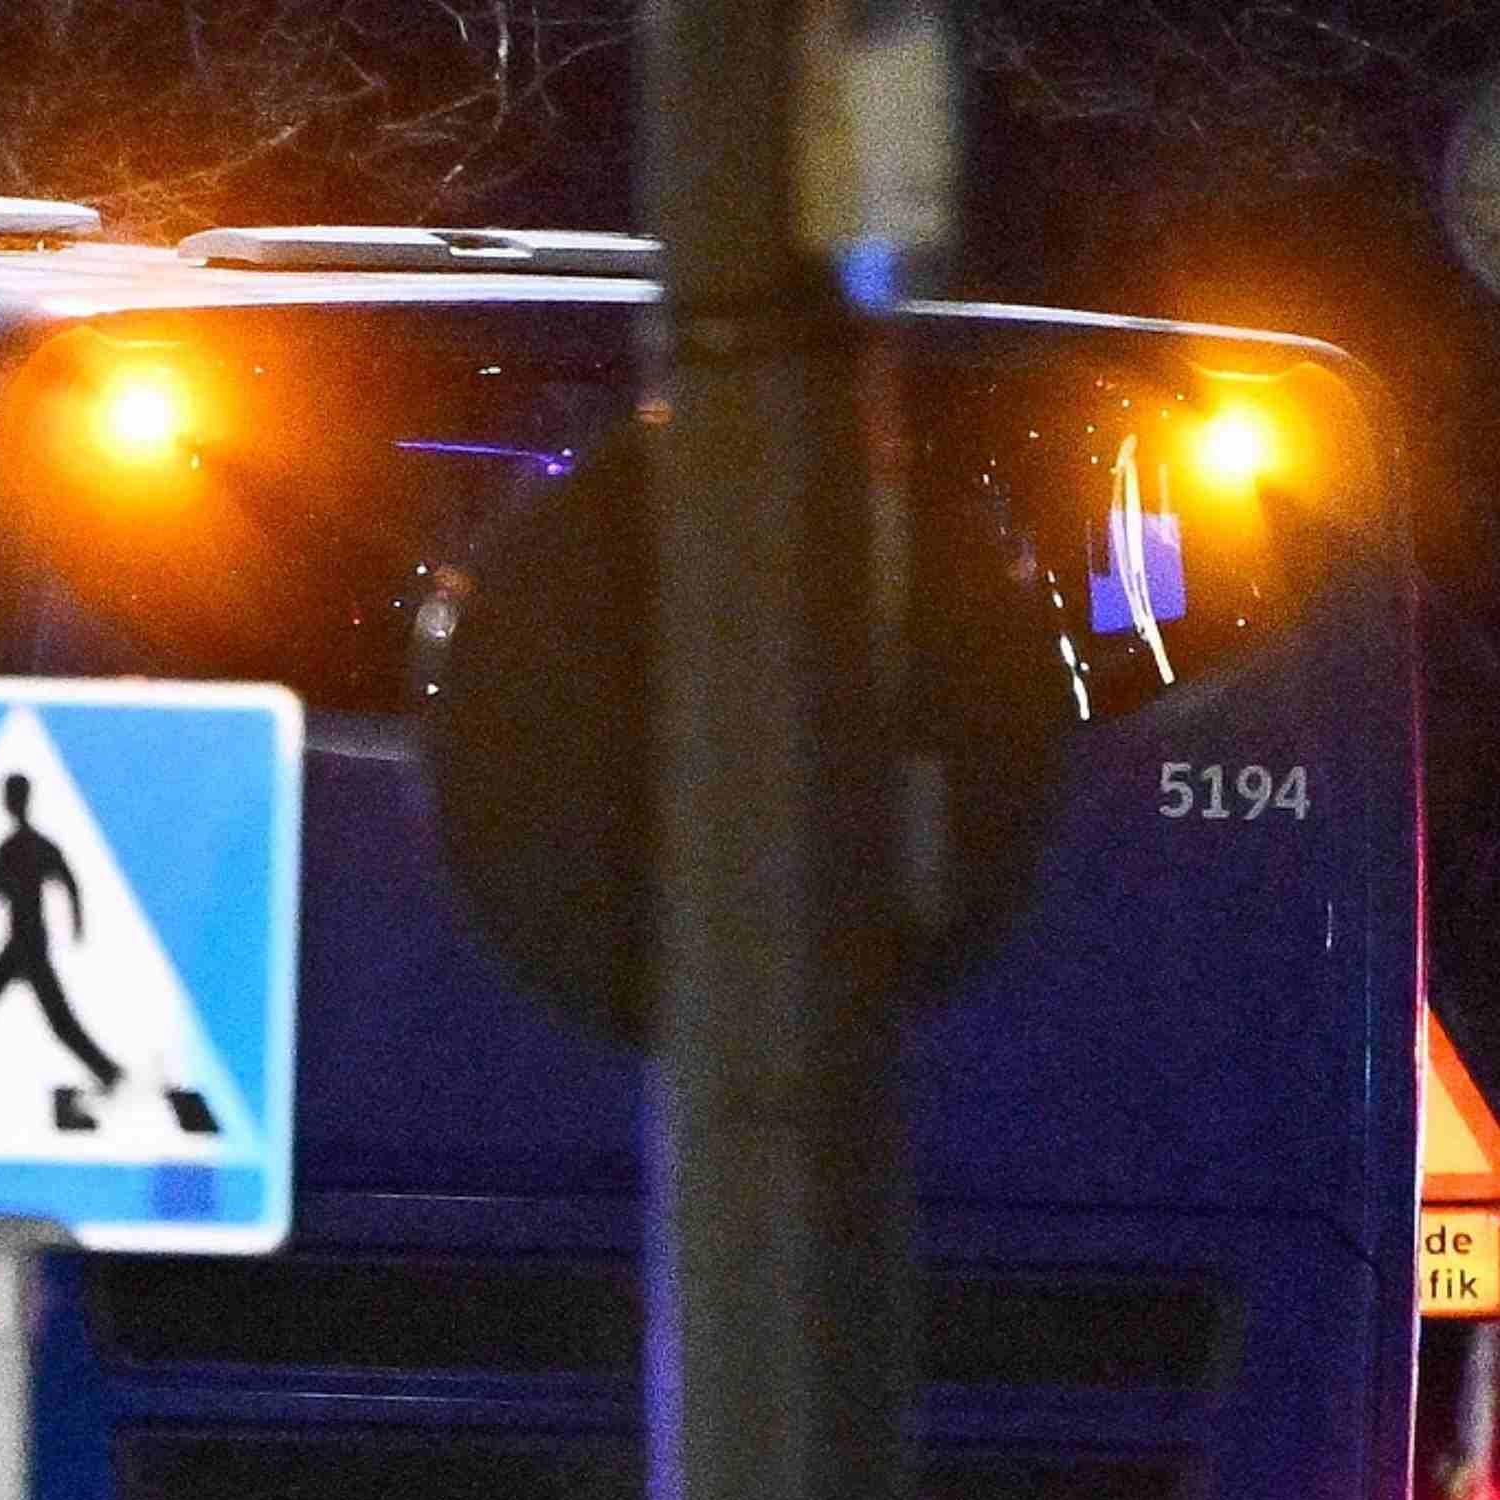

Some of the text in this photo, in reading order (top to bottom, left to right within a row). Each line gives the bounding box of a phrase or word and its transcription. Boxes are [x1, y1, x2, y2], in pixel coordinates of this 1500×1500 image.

[1159, 762, 1311, 820] 5194
[1424, 1224, 1474, 1255] de
[1429, 1268, 1479, 1299] fik
